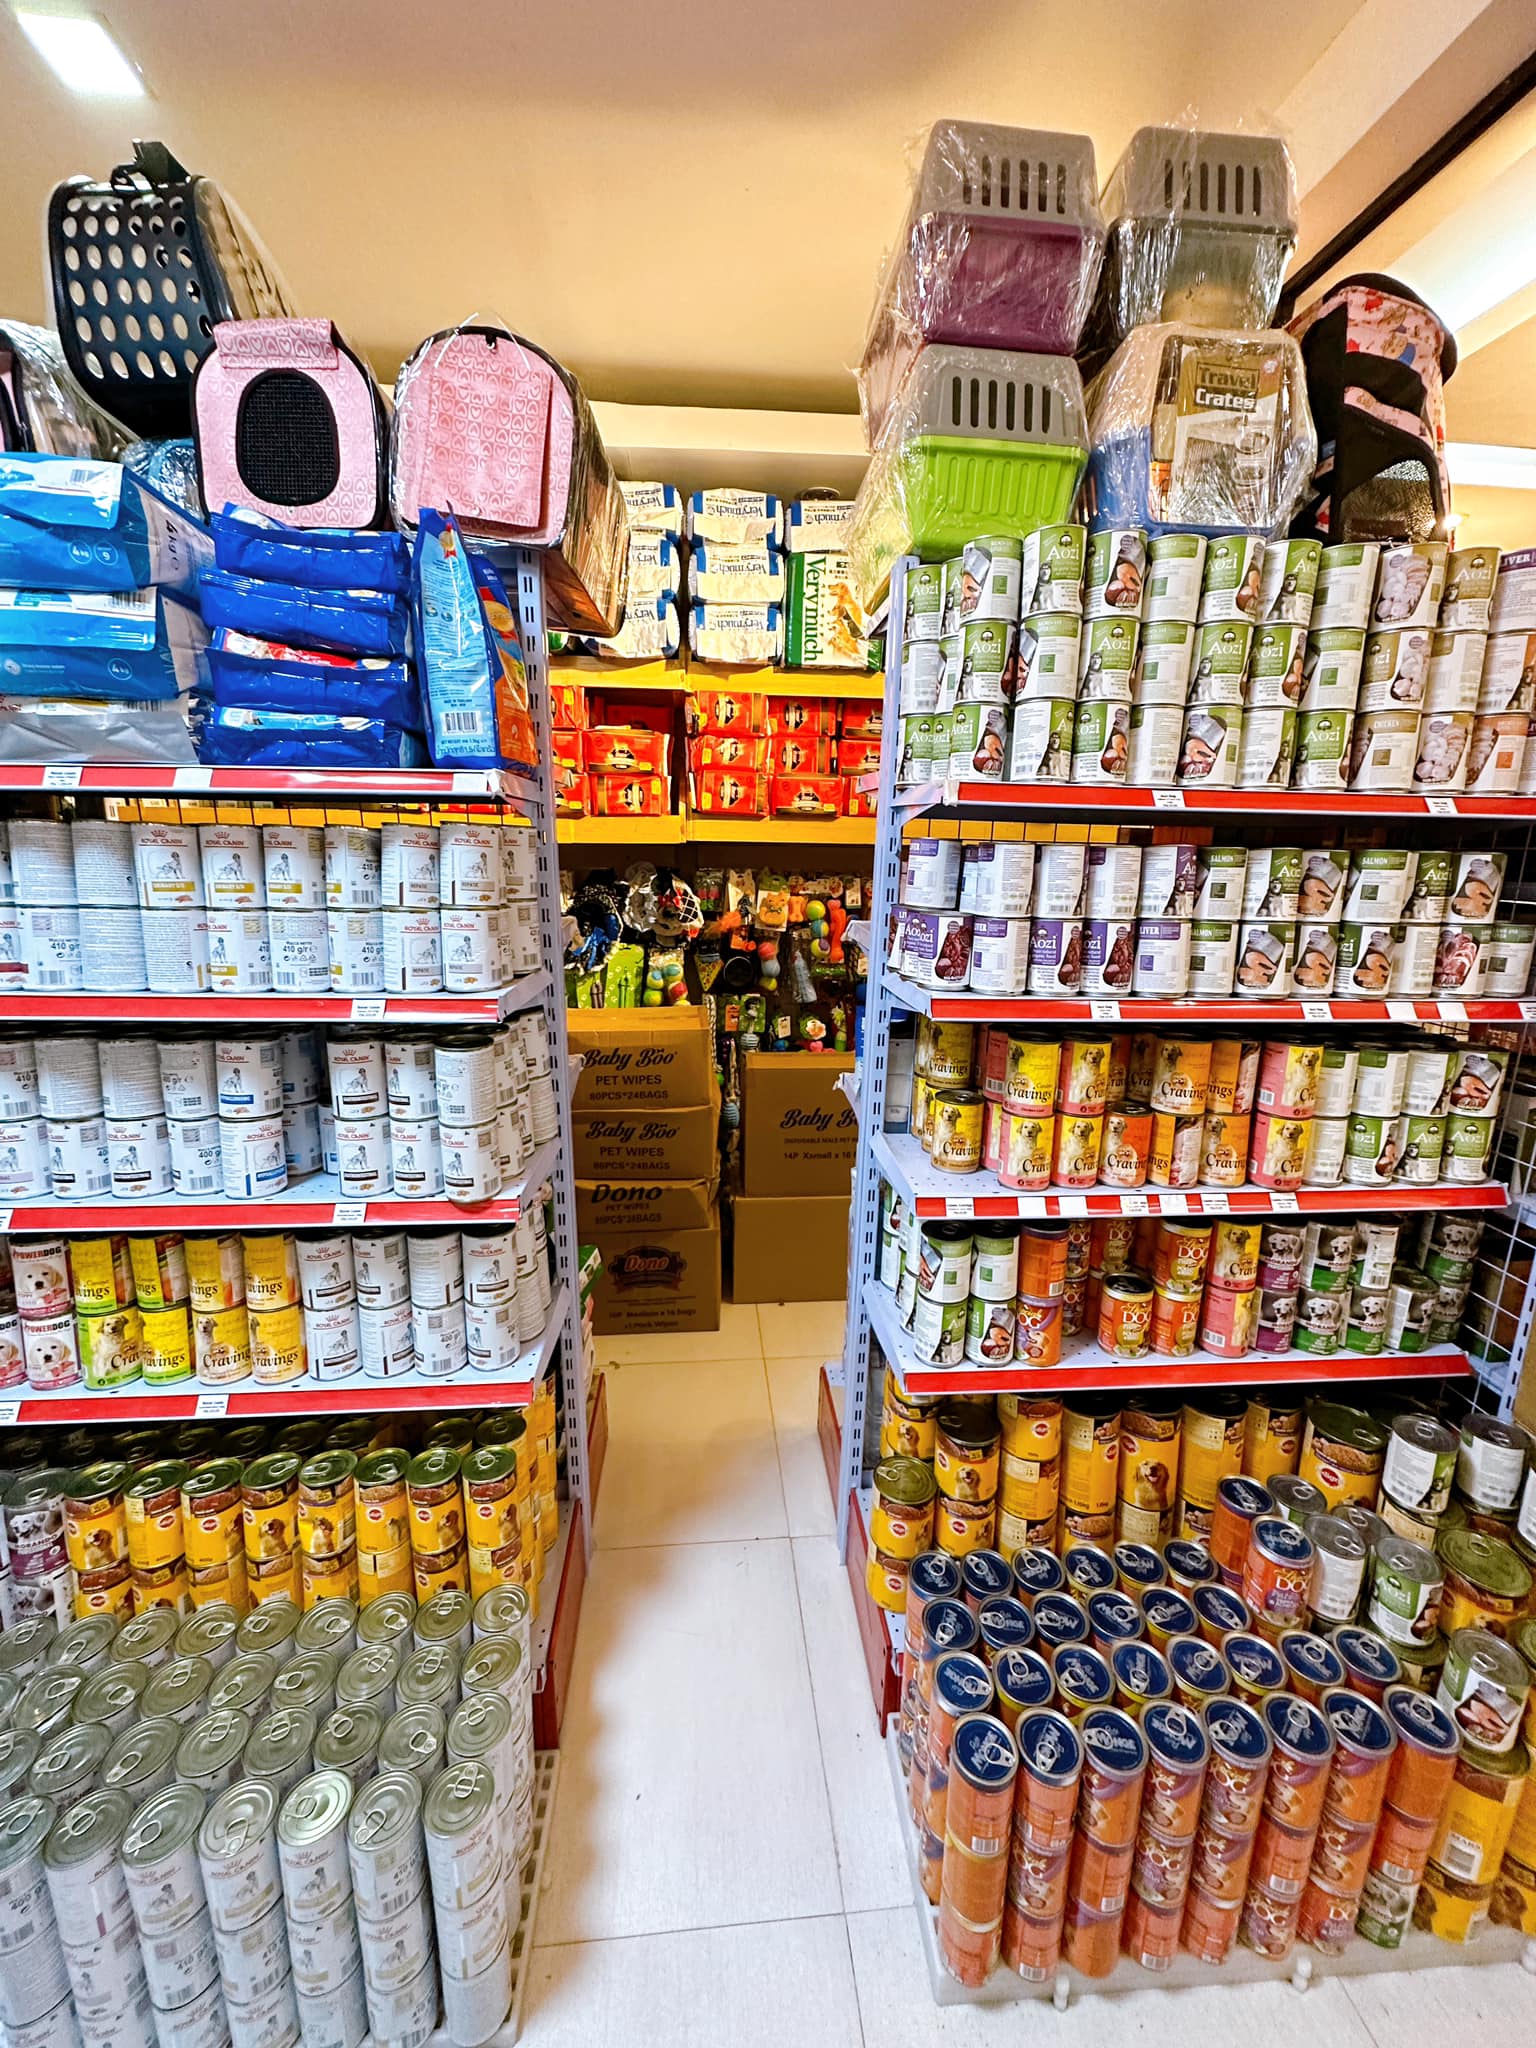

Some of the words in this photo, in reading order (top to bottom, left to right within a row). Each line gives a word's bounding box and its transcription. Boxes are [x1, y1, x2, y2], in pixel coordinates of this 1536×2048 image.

[1199, 366, 1256, 388] Travel
[1195, 388, 1256, 412] Crates
[715, 504, 763, 518] Verymuch
[1049, 544, 1079, 561] Aozi
[1206, 552, 1238, 569] Aozi
[719, 562, 766, 577] Verymuch
[1456, 564, 1492, 581] Aozi
[911, 583, 938, 596] Aozi
[803, 557, 827, 662] Verymuch
[969, 639, 1001, 654] Aozi
[1100, 633, 1131, 651] Aozi
[1208, 639, 1242, 655] Aozi
[1305, 726, 1340, 742] Aozi
[1362, 856, 1388, 865] SALMON
[1140, 926, 1160, 935] LIVER
[283, 945, 295, 953] 410
[1030, 934, 1058, 949] Aozi
[362, 946, 374, 954] 410
[582, 1048, 632, 1071] Baby
[595, 1075, 618, 1086] PET
[622, 1075, 662, 1085] WIPES
[1007, 1081, 1051, 1101] Cravings
[780, 1107, 834, 1131] Baby
[585, 1121, 636, 1143] Baby
[600, 1147, 621, 1156] PET
[625, 1147, 664, 1157] WIPES
[592, 1184, 663, 1204] Dono
[624, 1255, 670, 1271] Dono
